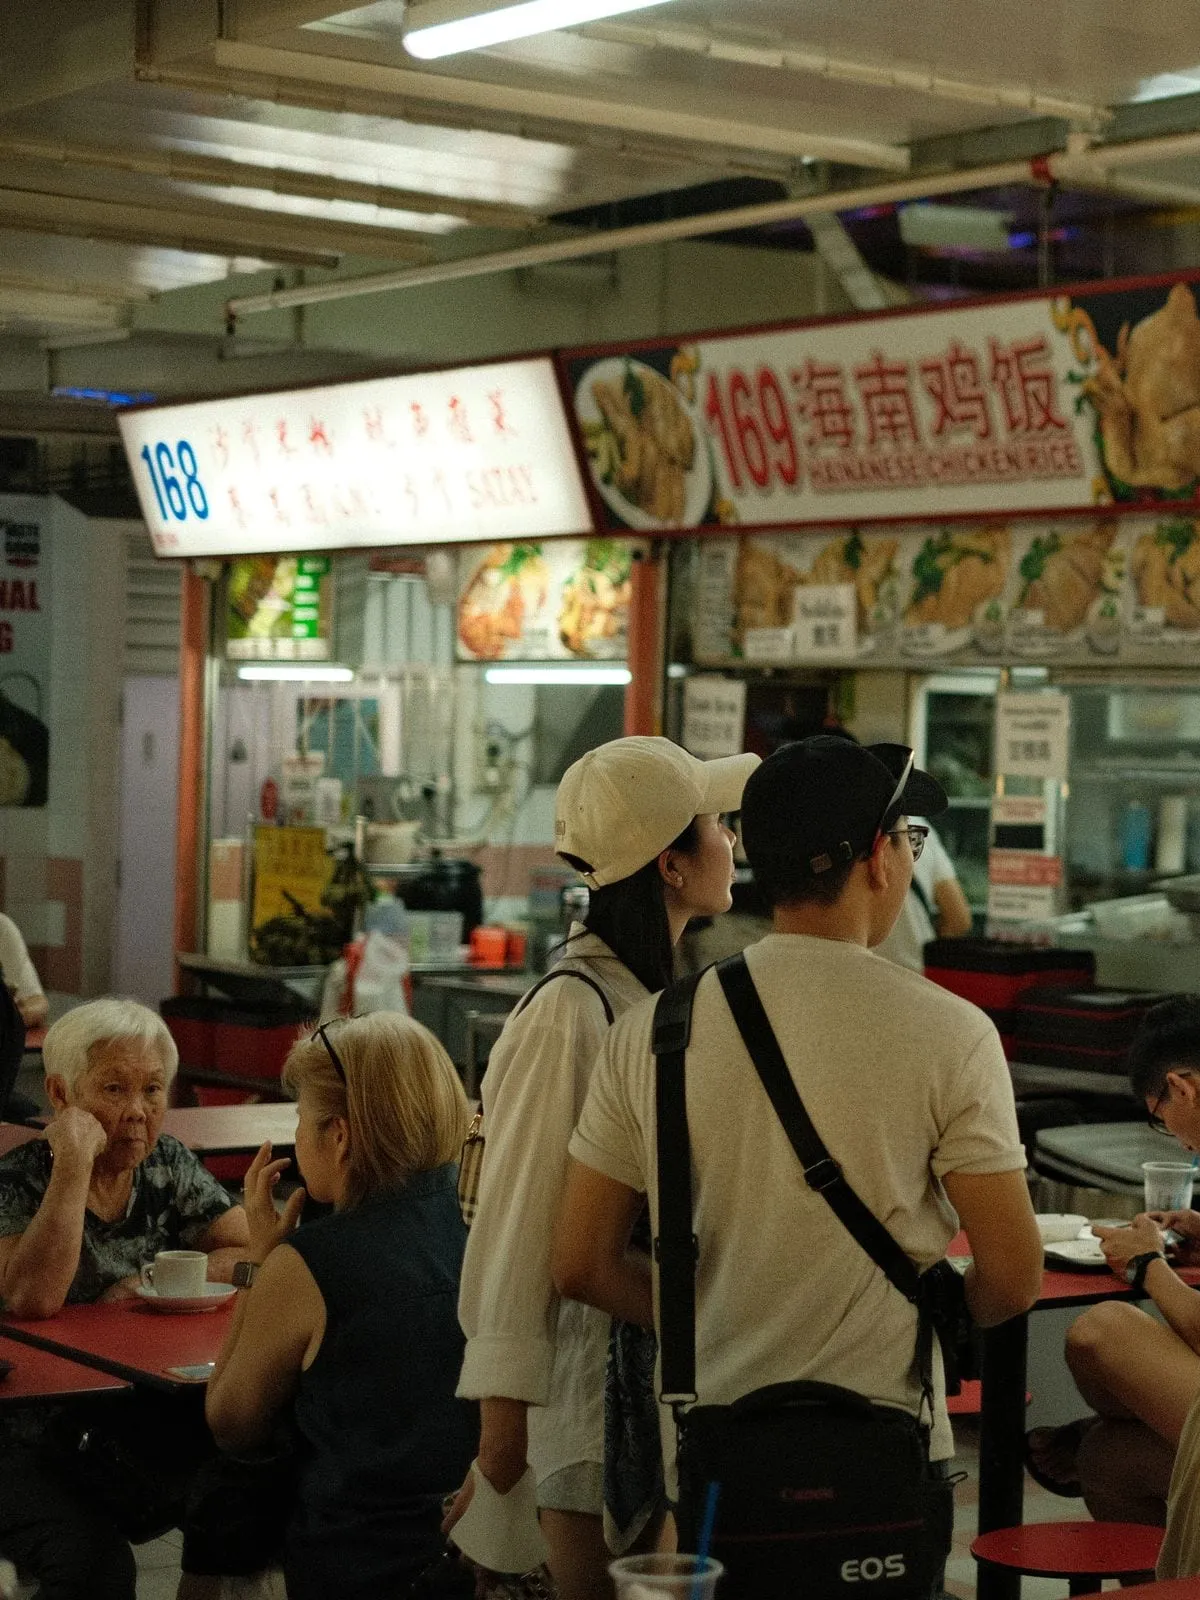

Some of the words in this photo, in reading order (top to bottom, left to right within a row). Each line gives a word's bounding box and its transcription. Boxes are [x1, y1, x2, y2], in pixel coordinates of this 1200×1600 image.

[706, 368, 798, 488] 169
[791, 334, 1066, 446] 海南鸡饭
[140, 439, 209, 522] 168
[811, 457, 917, 483] HAINANESE
[927, 449, 1021, 478] CHICKEN
[1026, 444, 1078, 472] RICE
[840, 1553, 906, 1583] EOS
